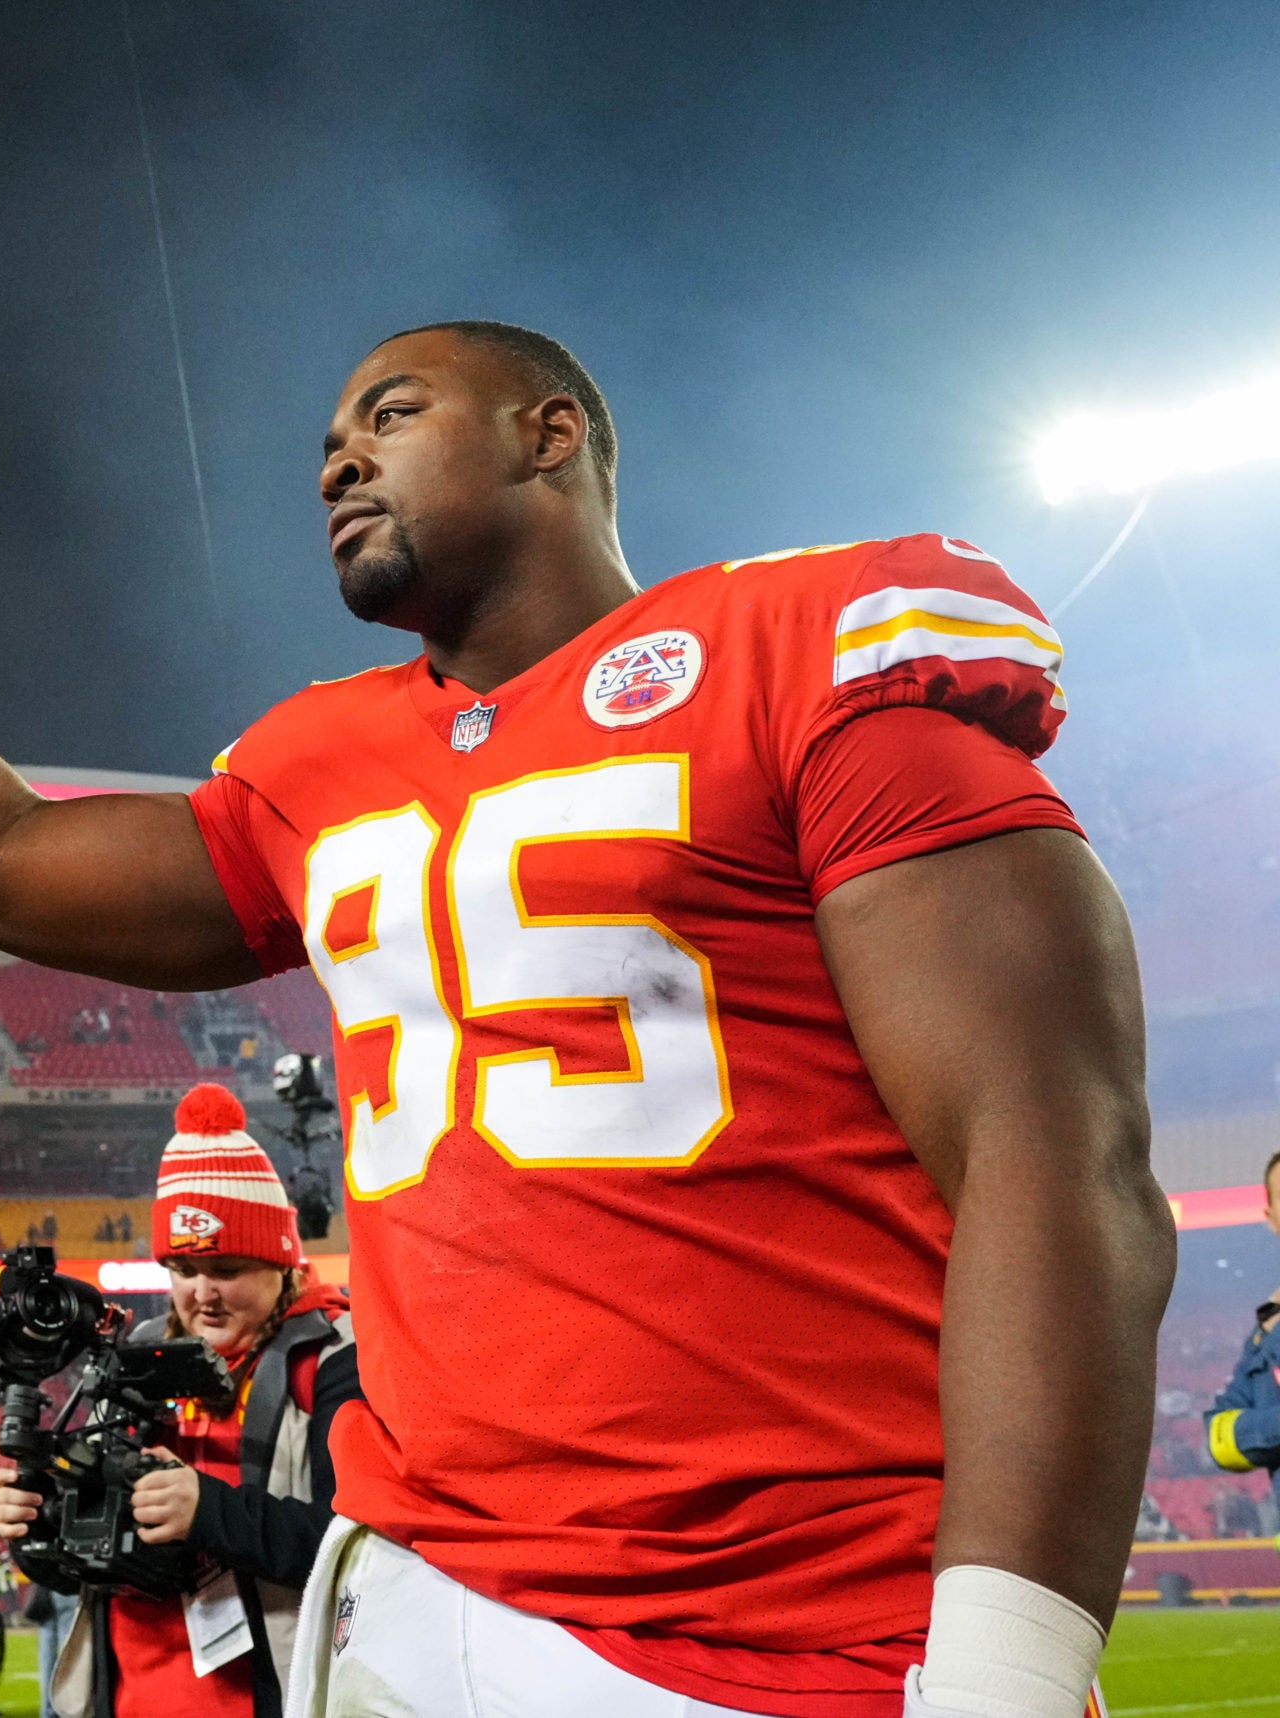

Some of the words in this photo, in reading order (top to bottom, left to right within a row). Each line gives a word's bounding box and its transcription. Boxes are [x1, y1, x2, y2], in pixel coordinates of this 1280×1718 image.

[456, 721, 483, 743] NFL
[304, 752, 735, 1202] 95
[181, 1213, 210, 1233] KC
